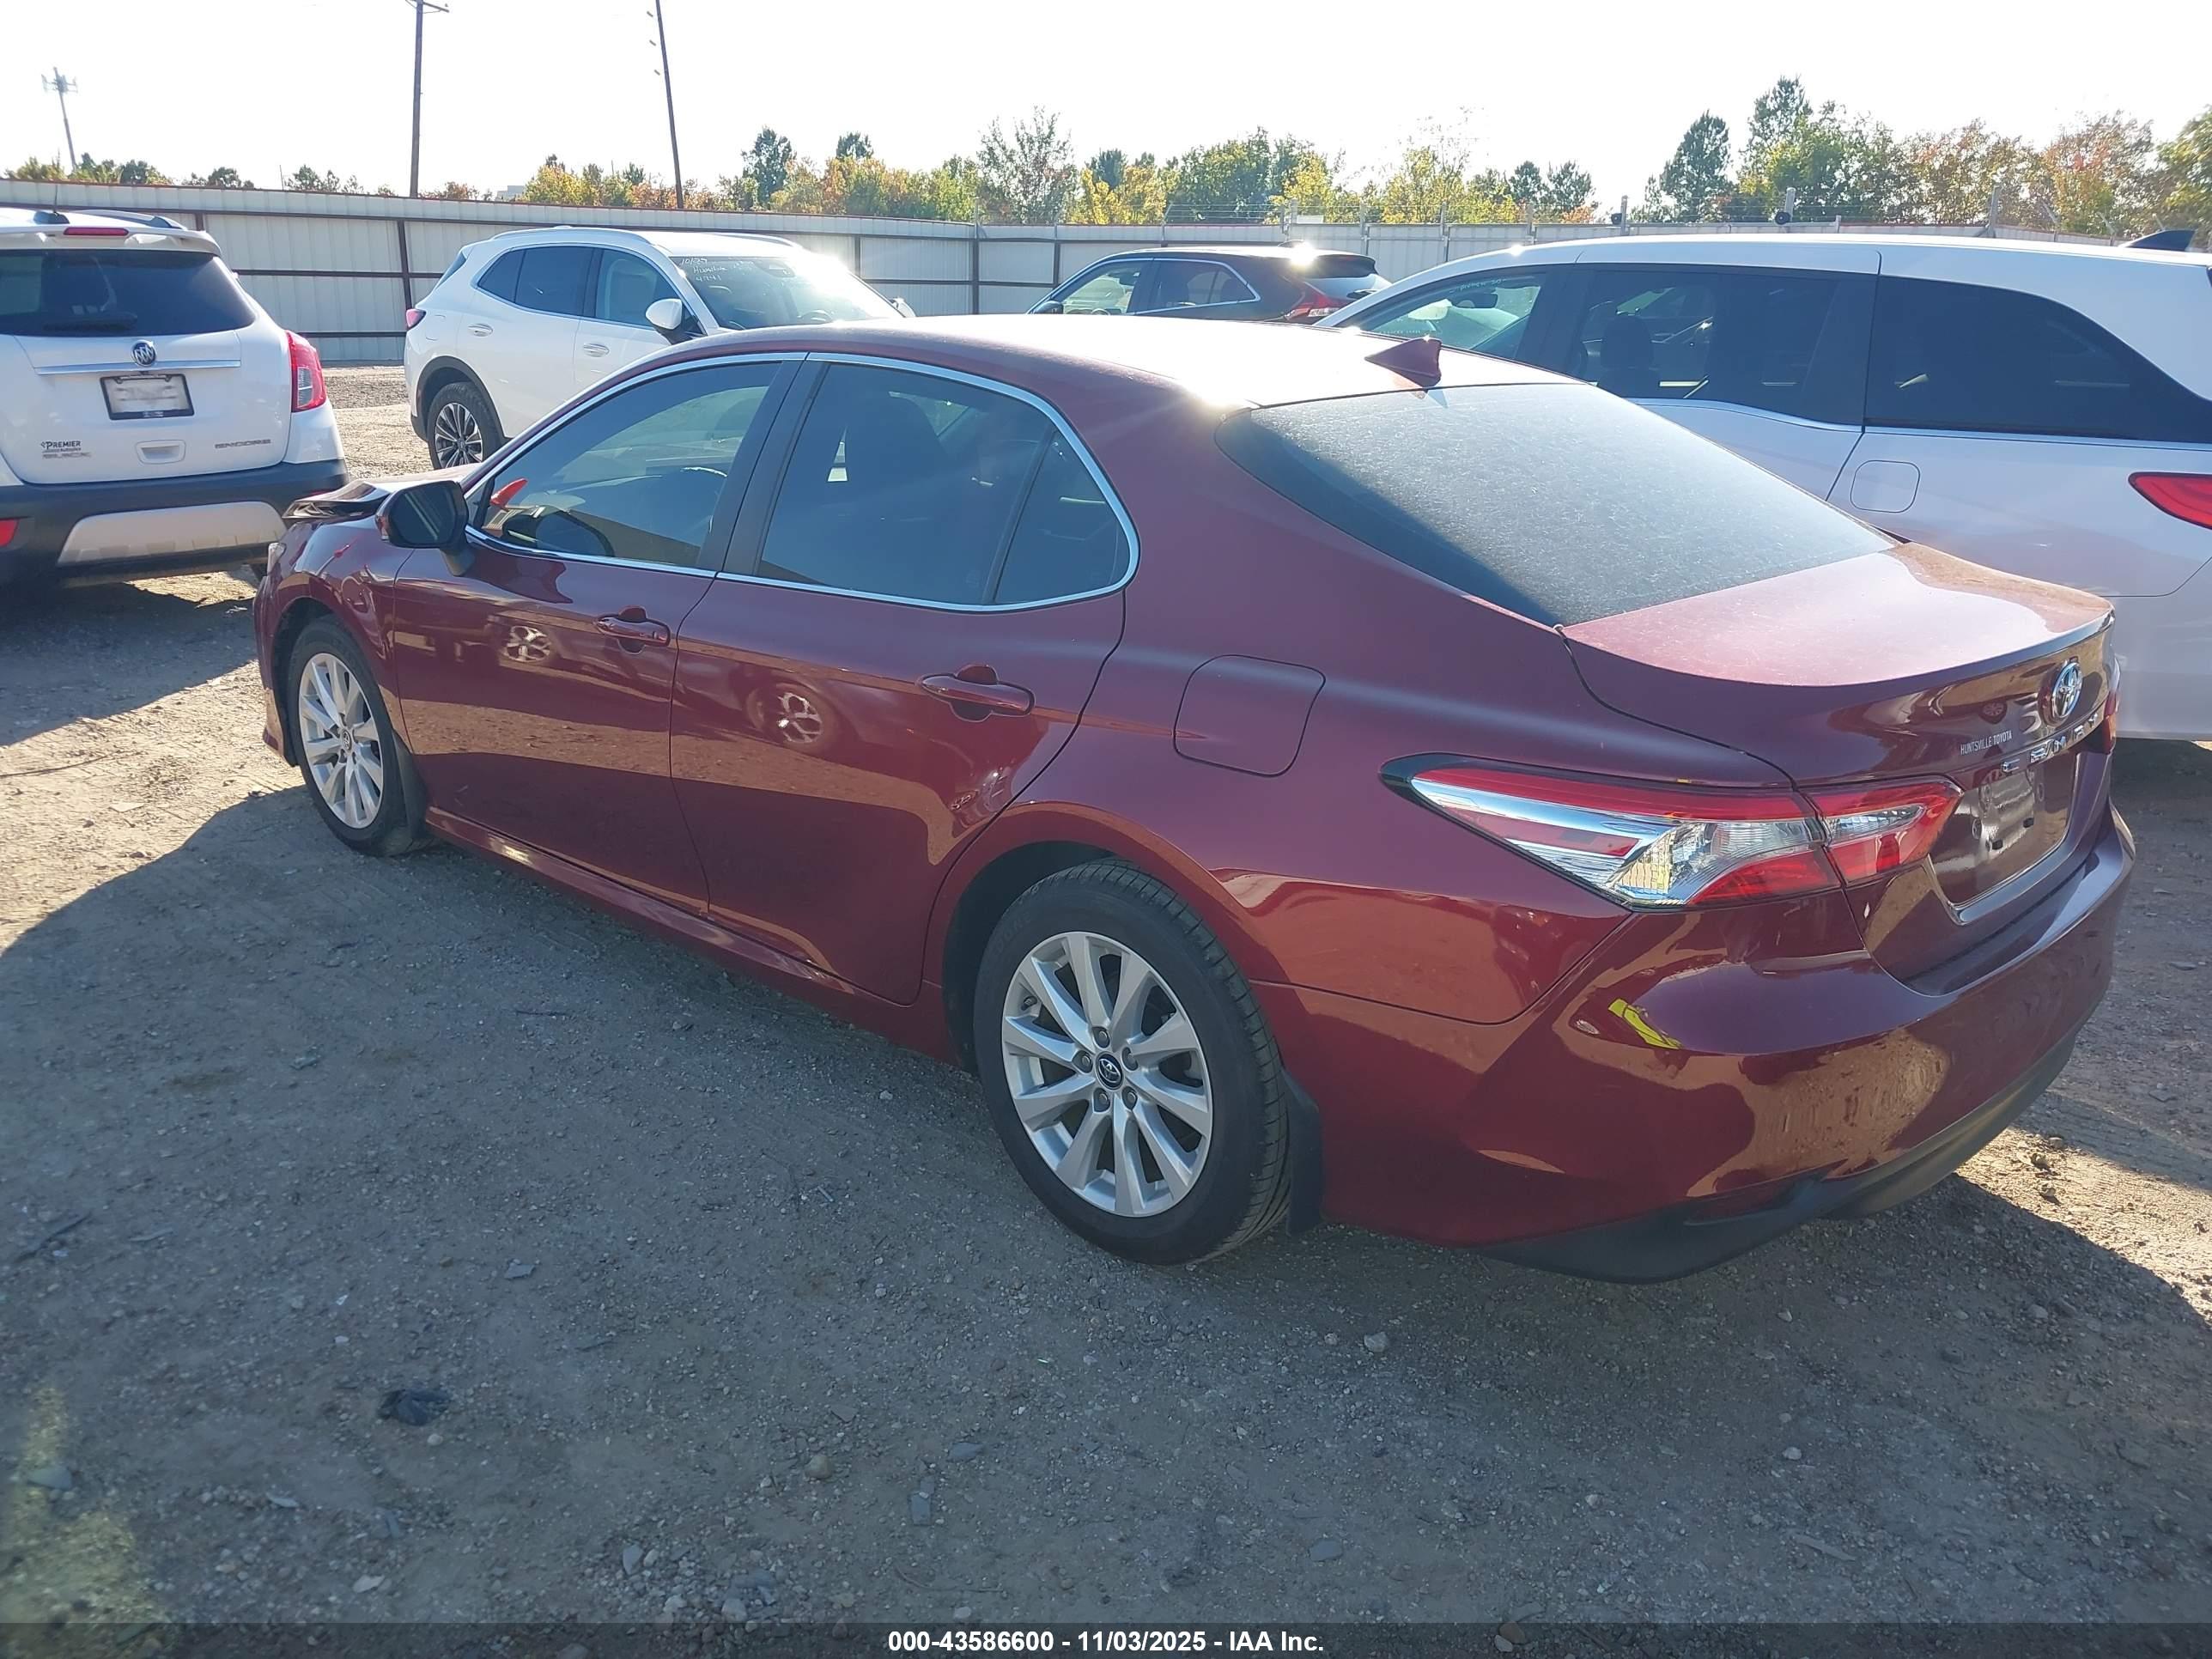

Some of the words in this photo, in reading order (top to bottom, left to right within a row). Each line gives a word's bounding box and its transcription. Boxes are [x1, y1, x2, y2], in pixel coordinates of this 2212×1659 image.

[46, 440, 82, 450] PREMIER
[1960, 736, 1993, 756] HUNTSVILLE
[1993, 730, 2013, 745] TOYOTA
